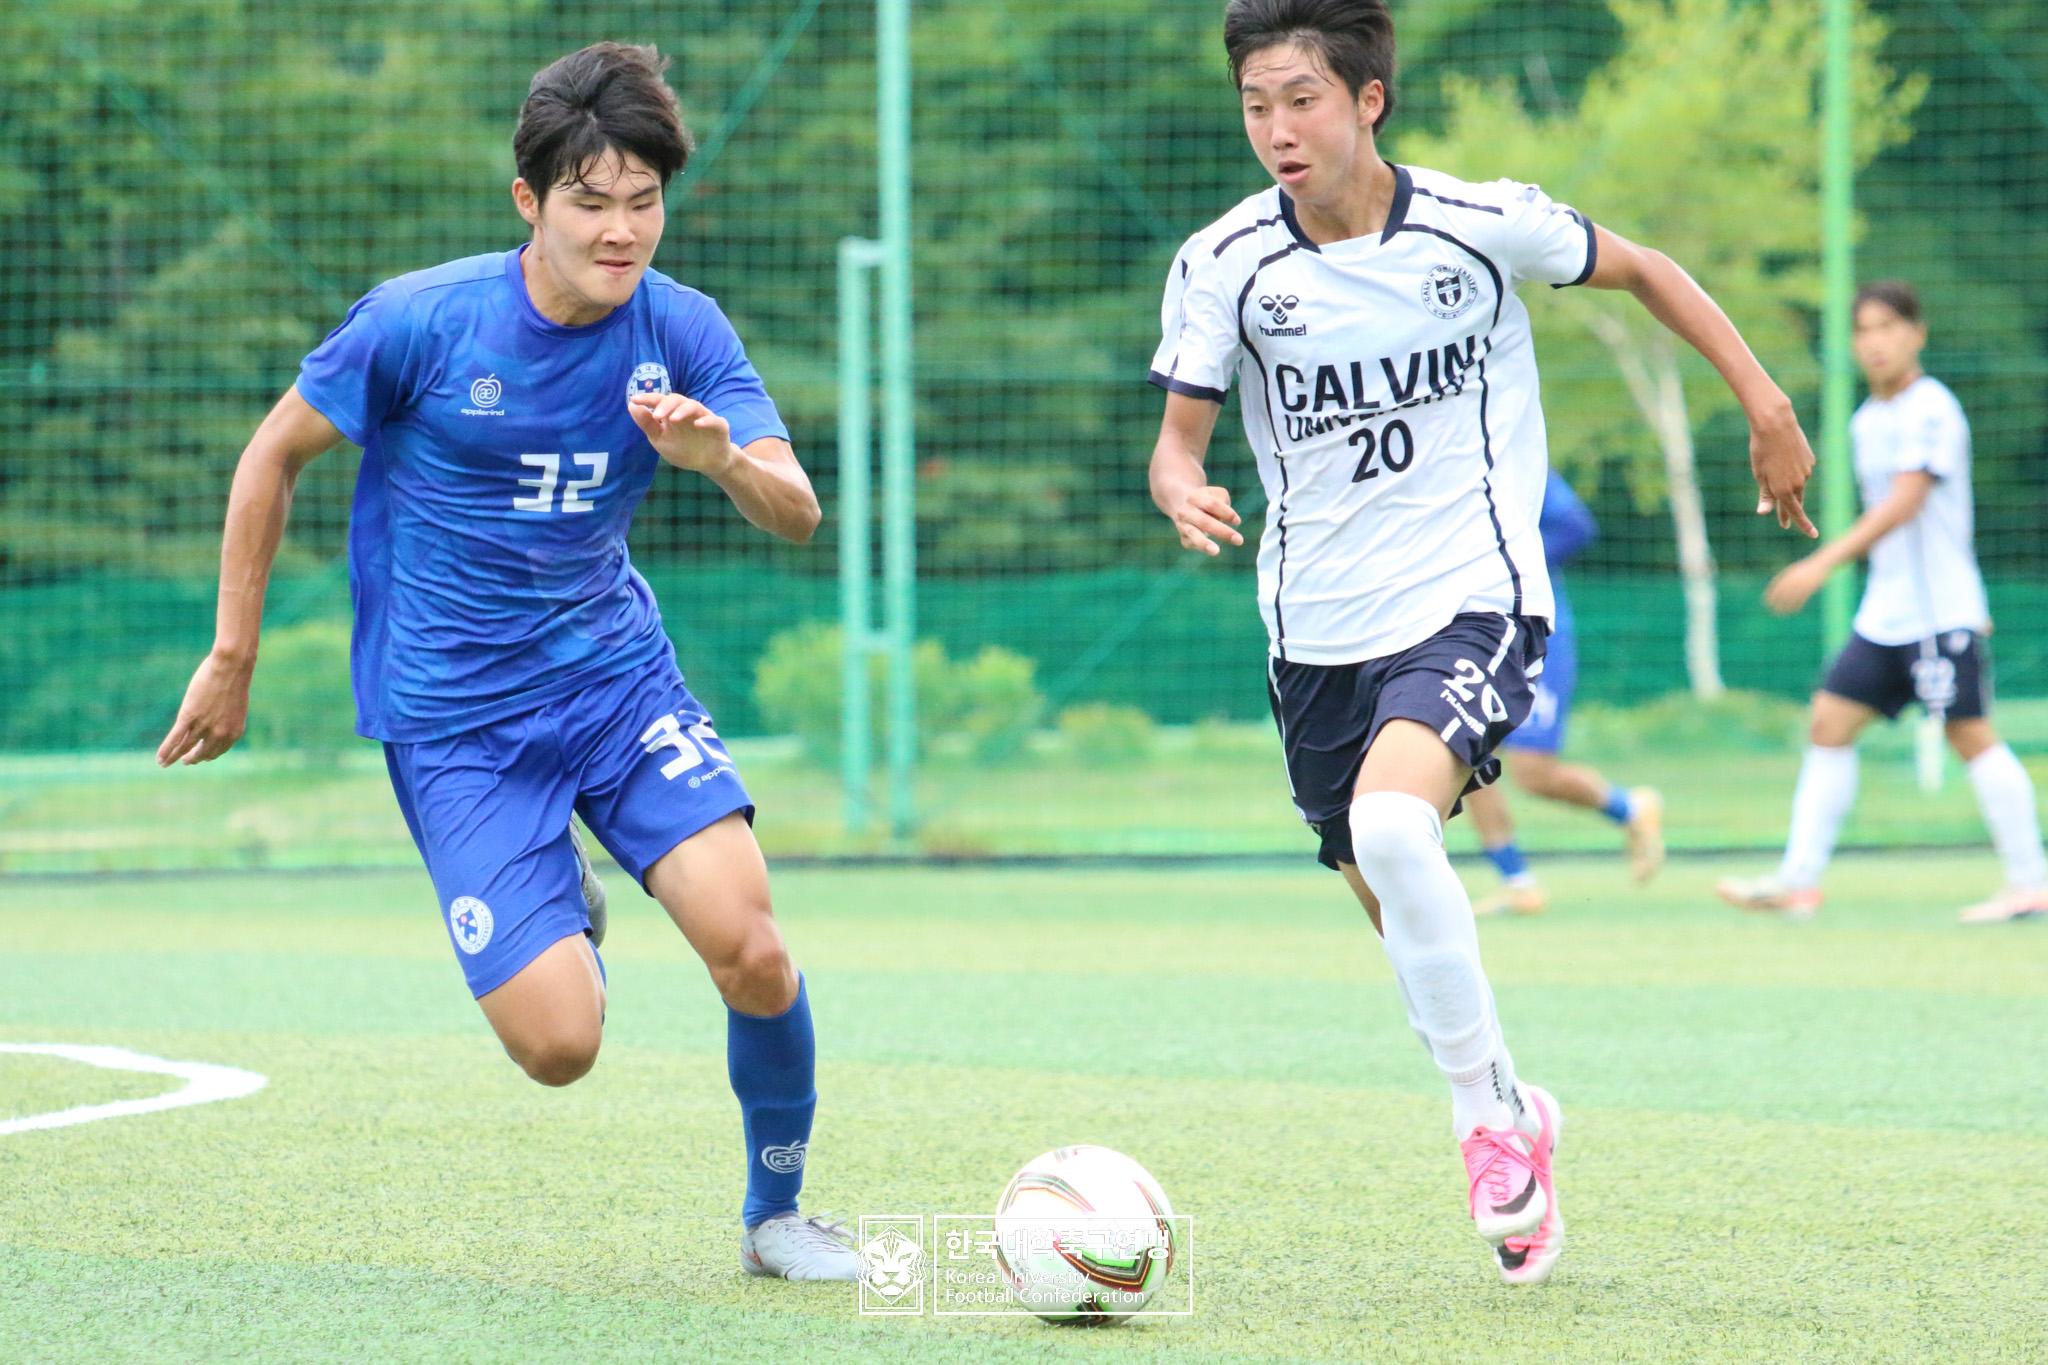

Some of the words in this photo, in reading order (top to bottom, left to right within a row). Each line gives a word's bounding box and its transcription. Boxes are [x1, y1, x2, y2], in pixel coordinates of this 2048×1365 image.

[1258, 323, 1307, 337] hummel
[1275, 334, 1476, 413] CALVIN
[460, 407, 505, 417] applerind
[1348, 418, 1415, 483] 20
[513, 451, 609, 513] 32
[1440, 688, 1487, 736] humme
[1442, 658, 1509, 723] 20
